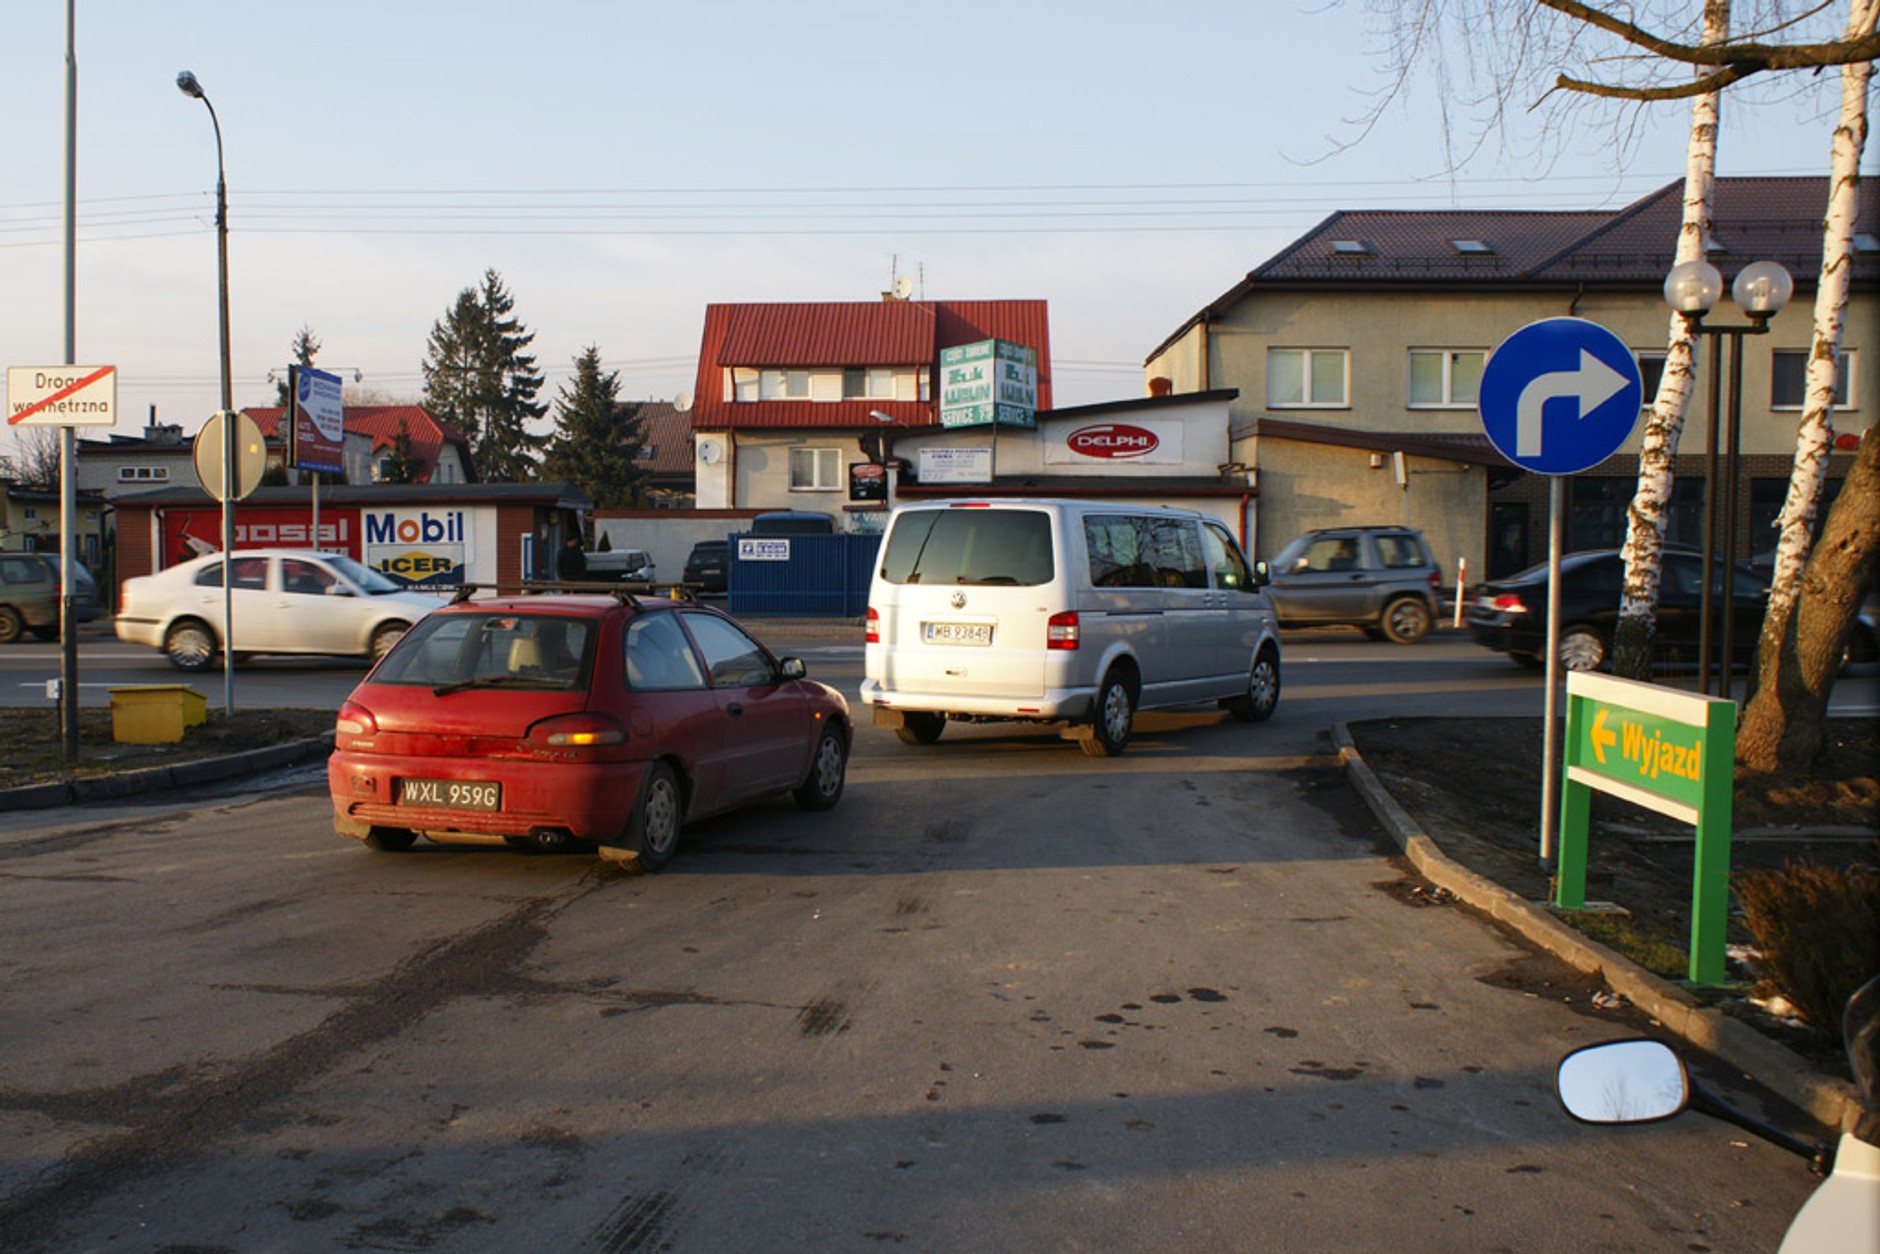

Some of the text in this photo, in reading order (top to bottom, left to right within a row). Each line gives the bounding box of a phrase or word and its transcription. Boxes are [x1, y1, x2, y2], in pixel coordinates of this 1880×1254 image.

[35, 372, 88, 391] Drog
[942, 407, 974, 427] SERVICE
[1077, 435, 1147, 447] DELPHI
[366, 512, 464, 543] Mobil
[382, 558, 453, 573] ICER
[1622, 720, 1702, 782] Wyjazd
[405, 782, 496, 807] WXL 959G
